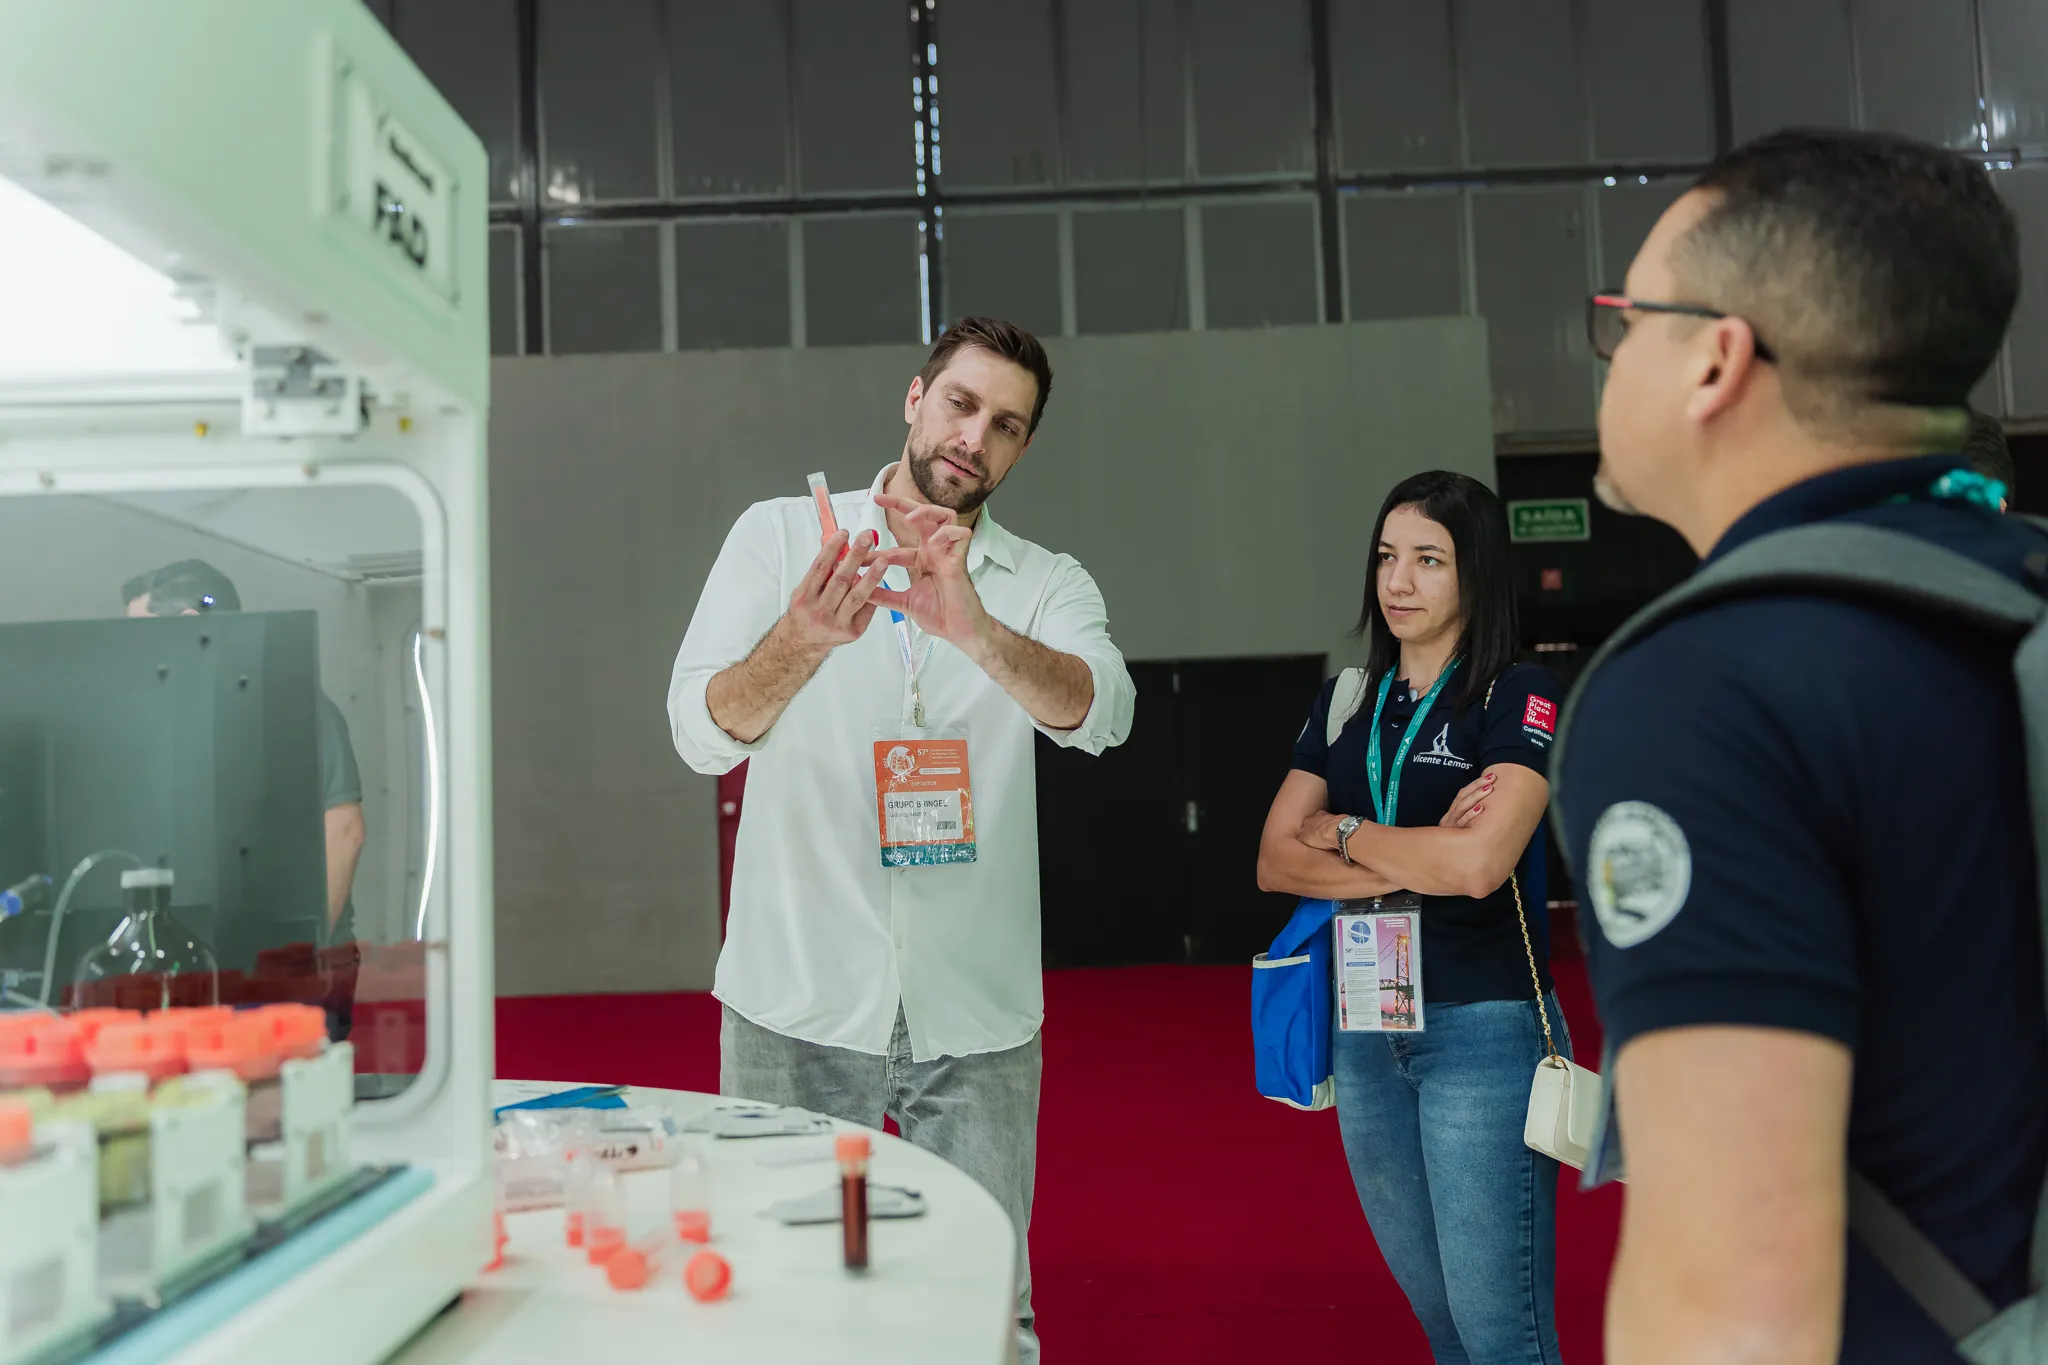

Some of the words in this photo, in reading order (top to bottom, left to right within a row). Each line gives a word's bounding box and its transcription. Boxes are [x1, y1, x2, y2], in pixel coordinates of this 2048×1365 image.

[1528, 702, 1550, 716] Place
[1529, 696, 1551, 710] Great
[1523, 725, 1553, 741] Certificado
[1412, 754, 1442, 765] Vicente
[887, 800, 915, 809] GRUPO
